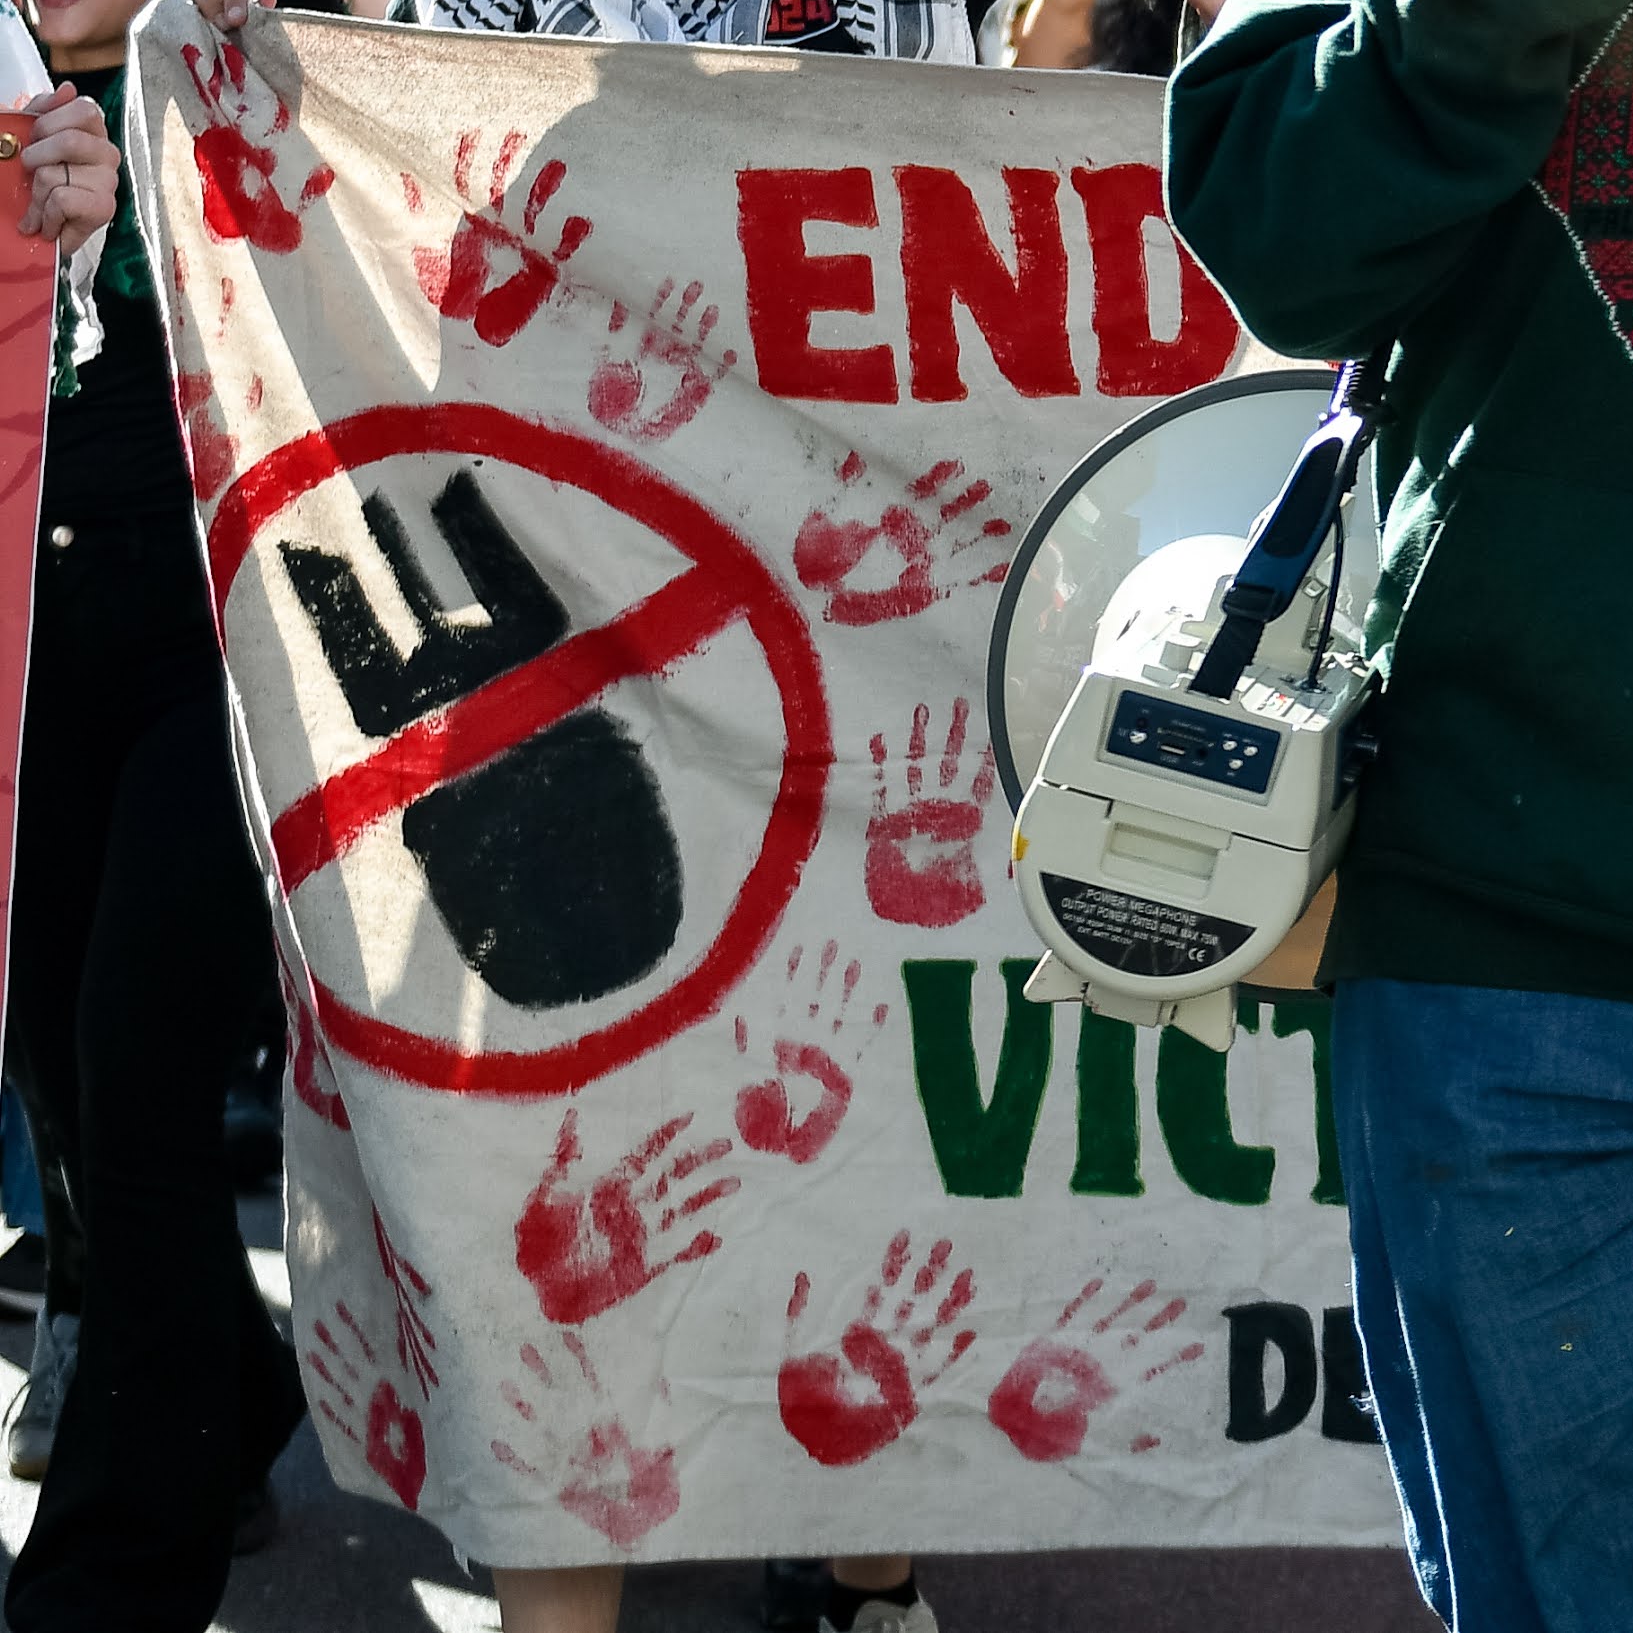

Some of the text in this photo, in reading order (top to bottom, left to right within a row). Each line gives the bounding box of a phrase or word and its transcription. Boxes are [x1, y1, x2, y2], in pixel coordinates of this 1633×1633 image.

[735, 163, 1242, 404] END
[1061, 897, 1097, 915] OUTPUT
[1097, 906, 1128, 923] POWER
[1086, 888, 1126, 909] POWER
[1130, 899, 1198, 927] MEGAPHONE
[1187, 947, 1207, 963] CE
